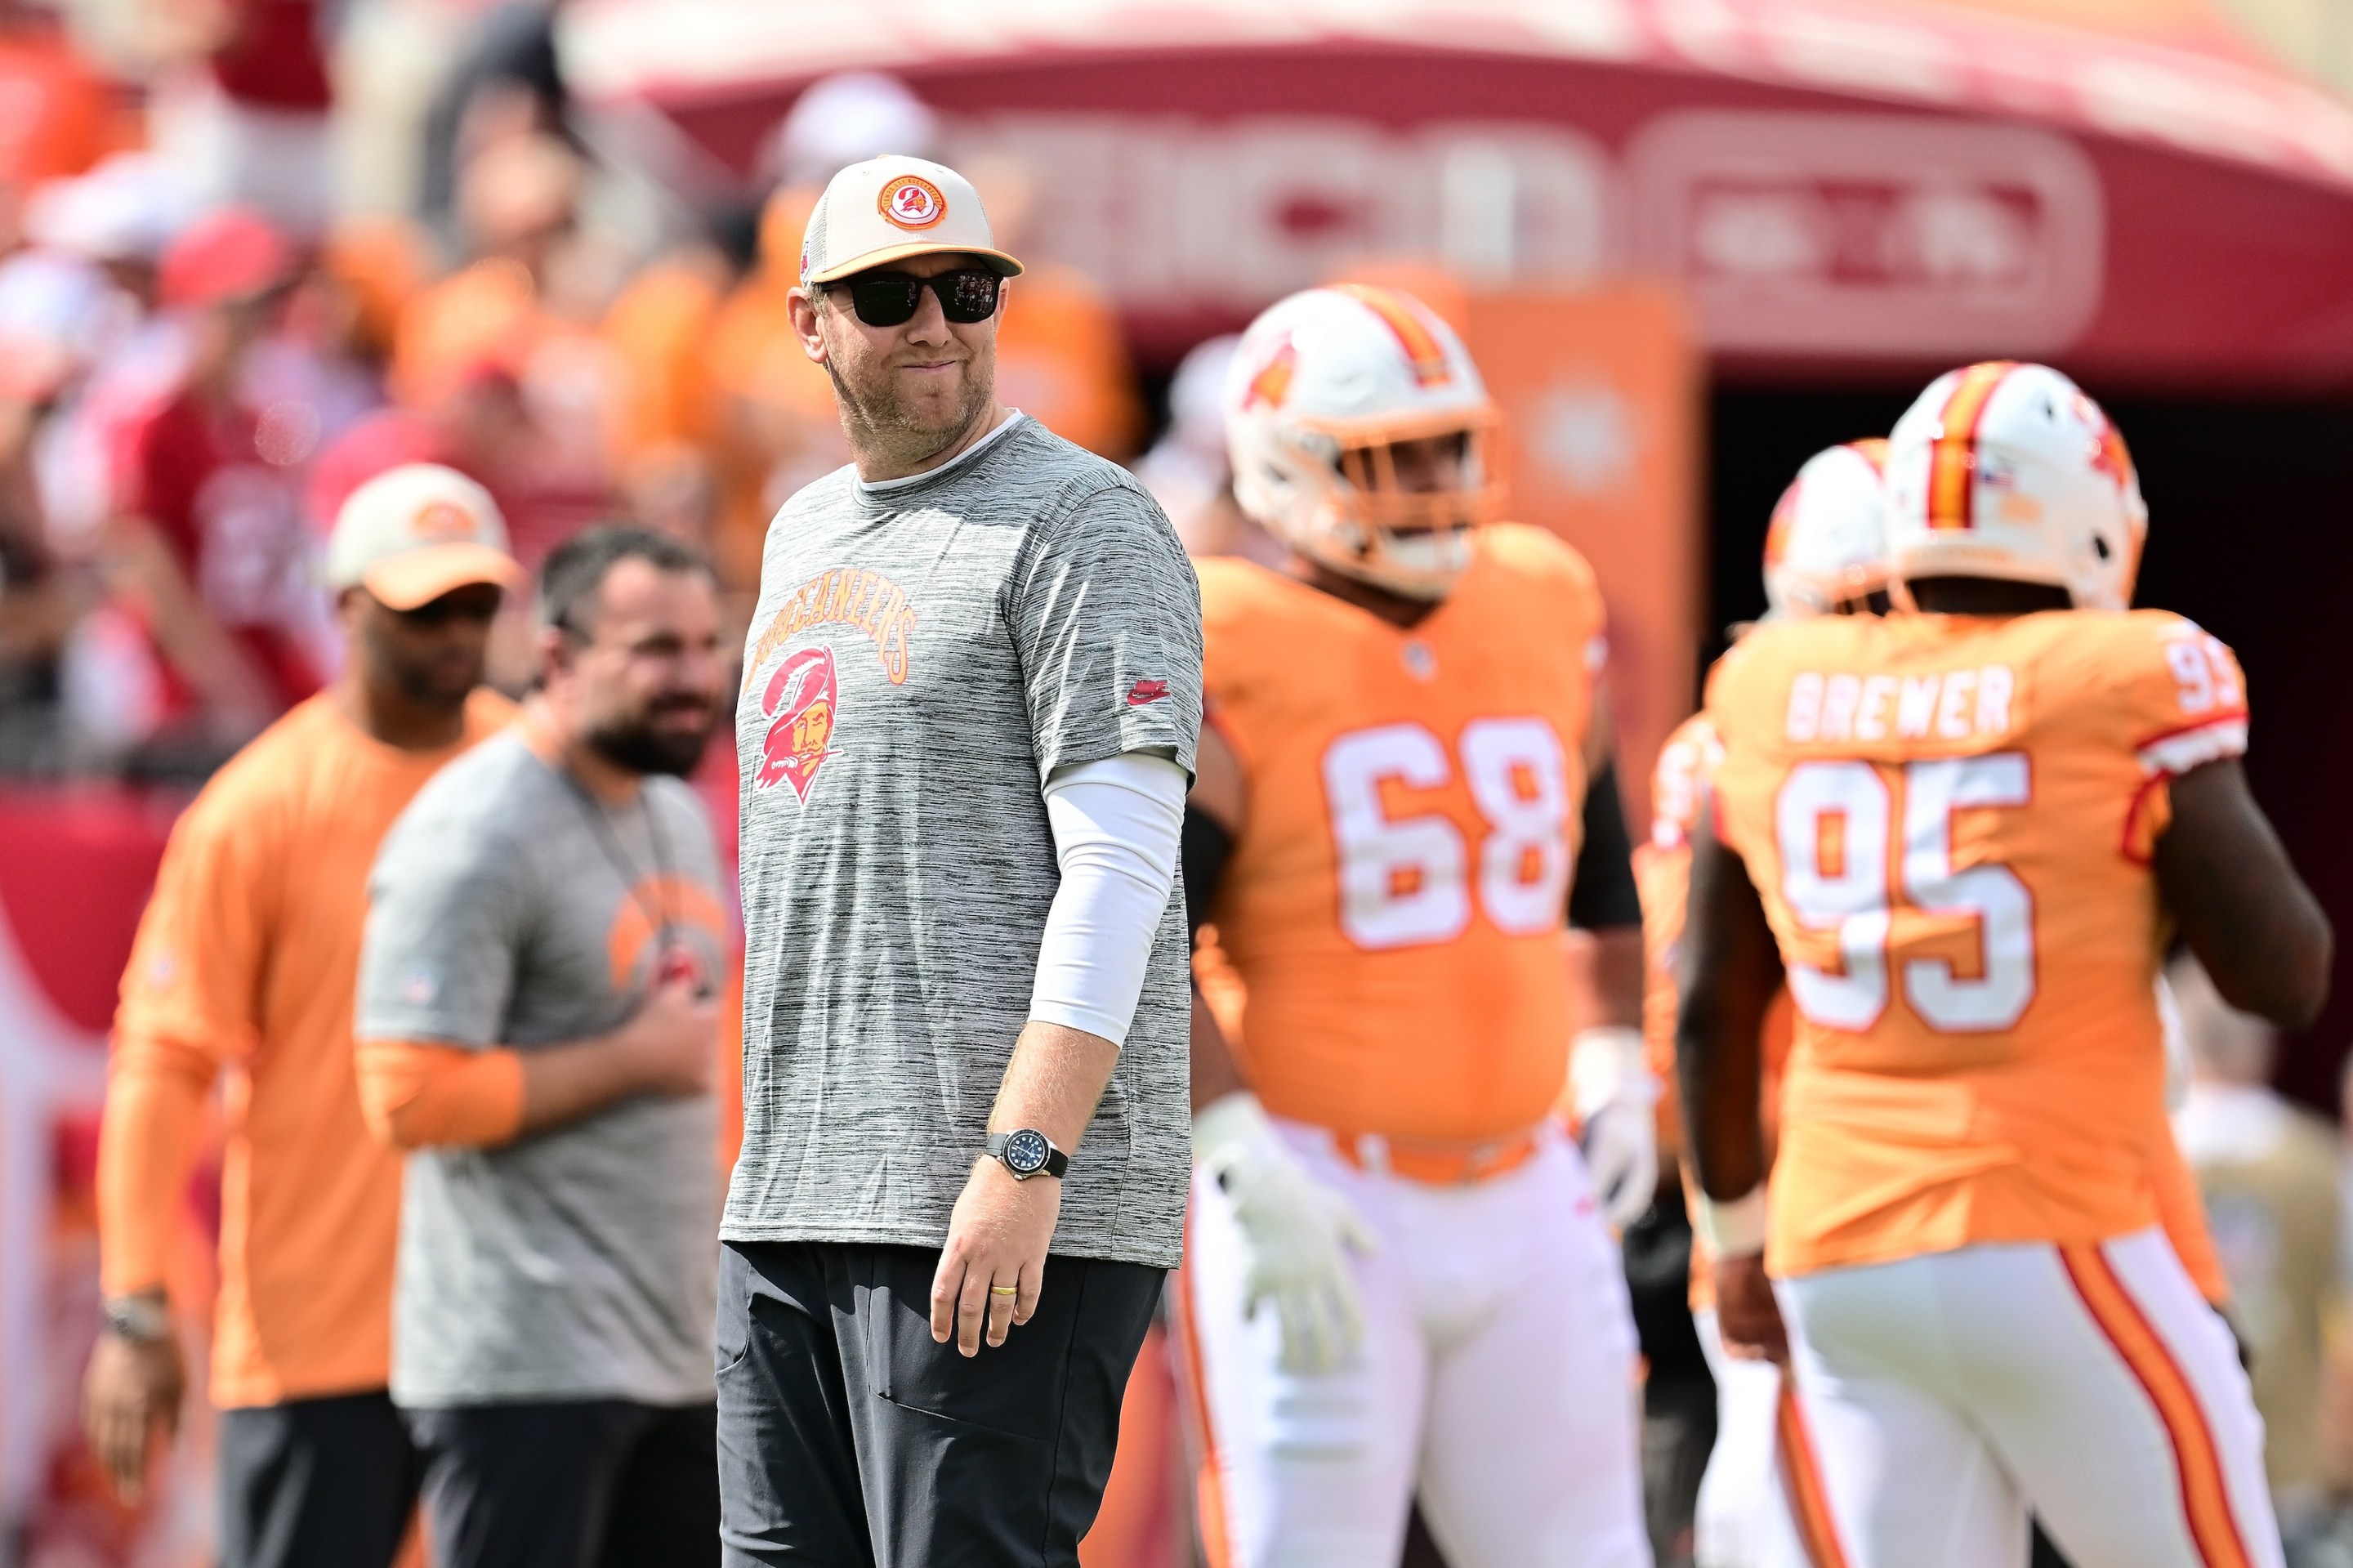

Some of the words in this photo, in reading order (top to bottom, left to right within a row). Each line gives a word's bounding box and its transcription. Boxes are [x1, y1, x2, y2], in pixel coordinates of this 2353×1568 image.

[883, 187, 895, 206] TAMPA
[893, 179, 906, 188] BAY
[907, 178, 941, 204] BUCCANEERS
[1785, 665, 2015, 743] BREWER
[2163, 637, 2240, 713] 95
[1320, 715, 1572, 951] 68
[1775, 751, 2037, 1033] 95
